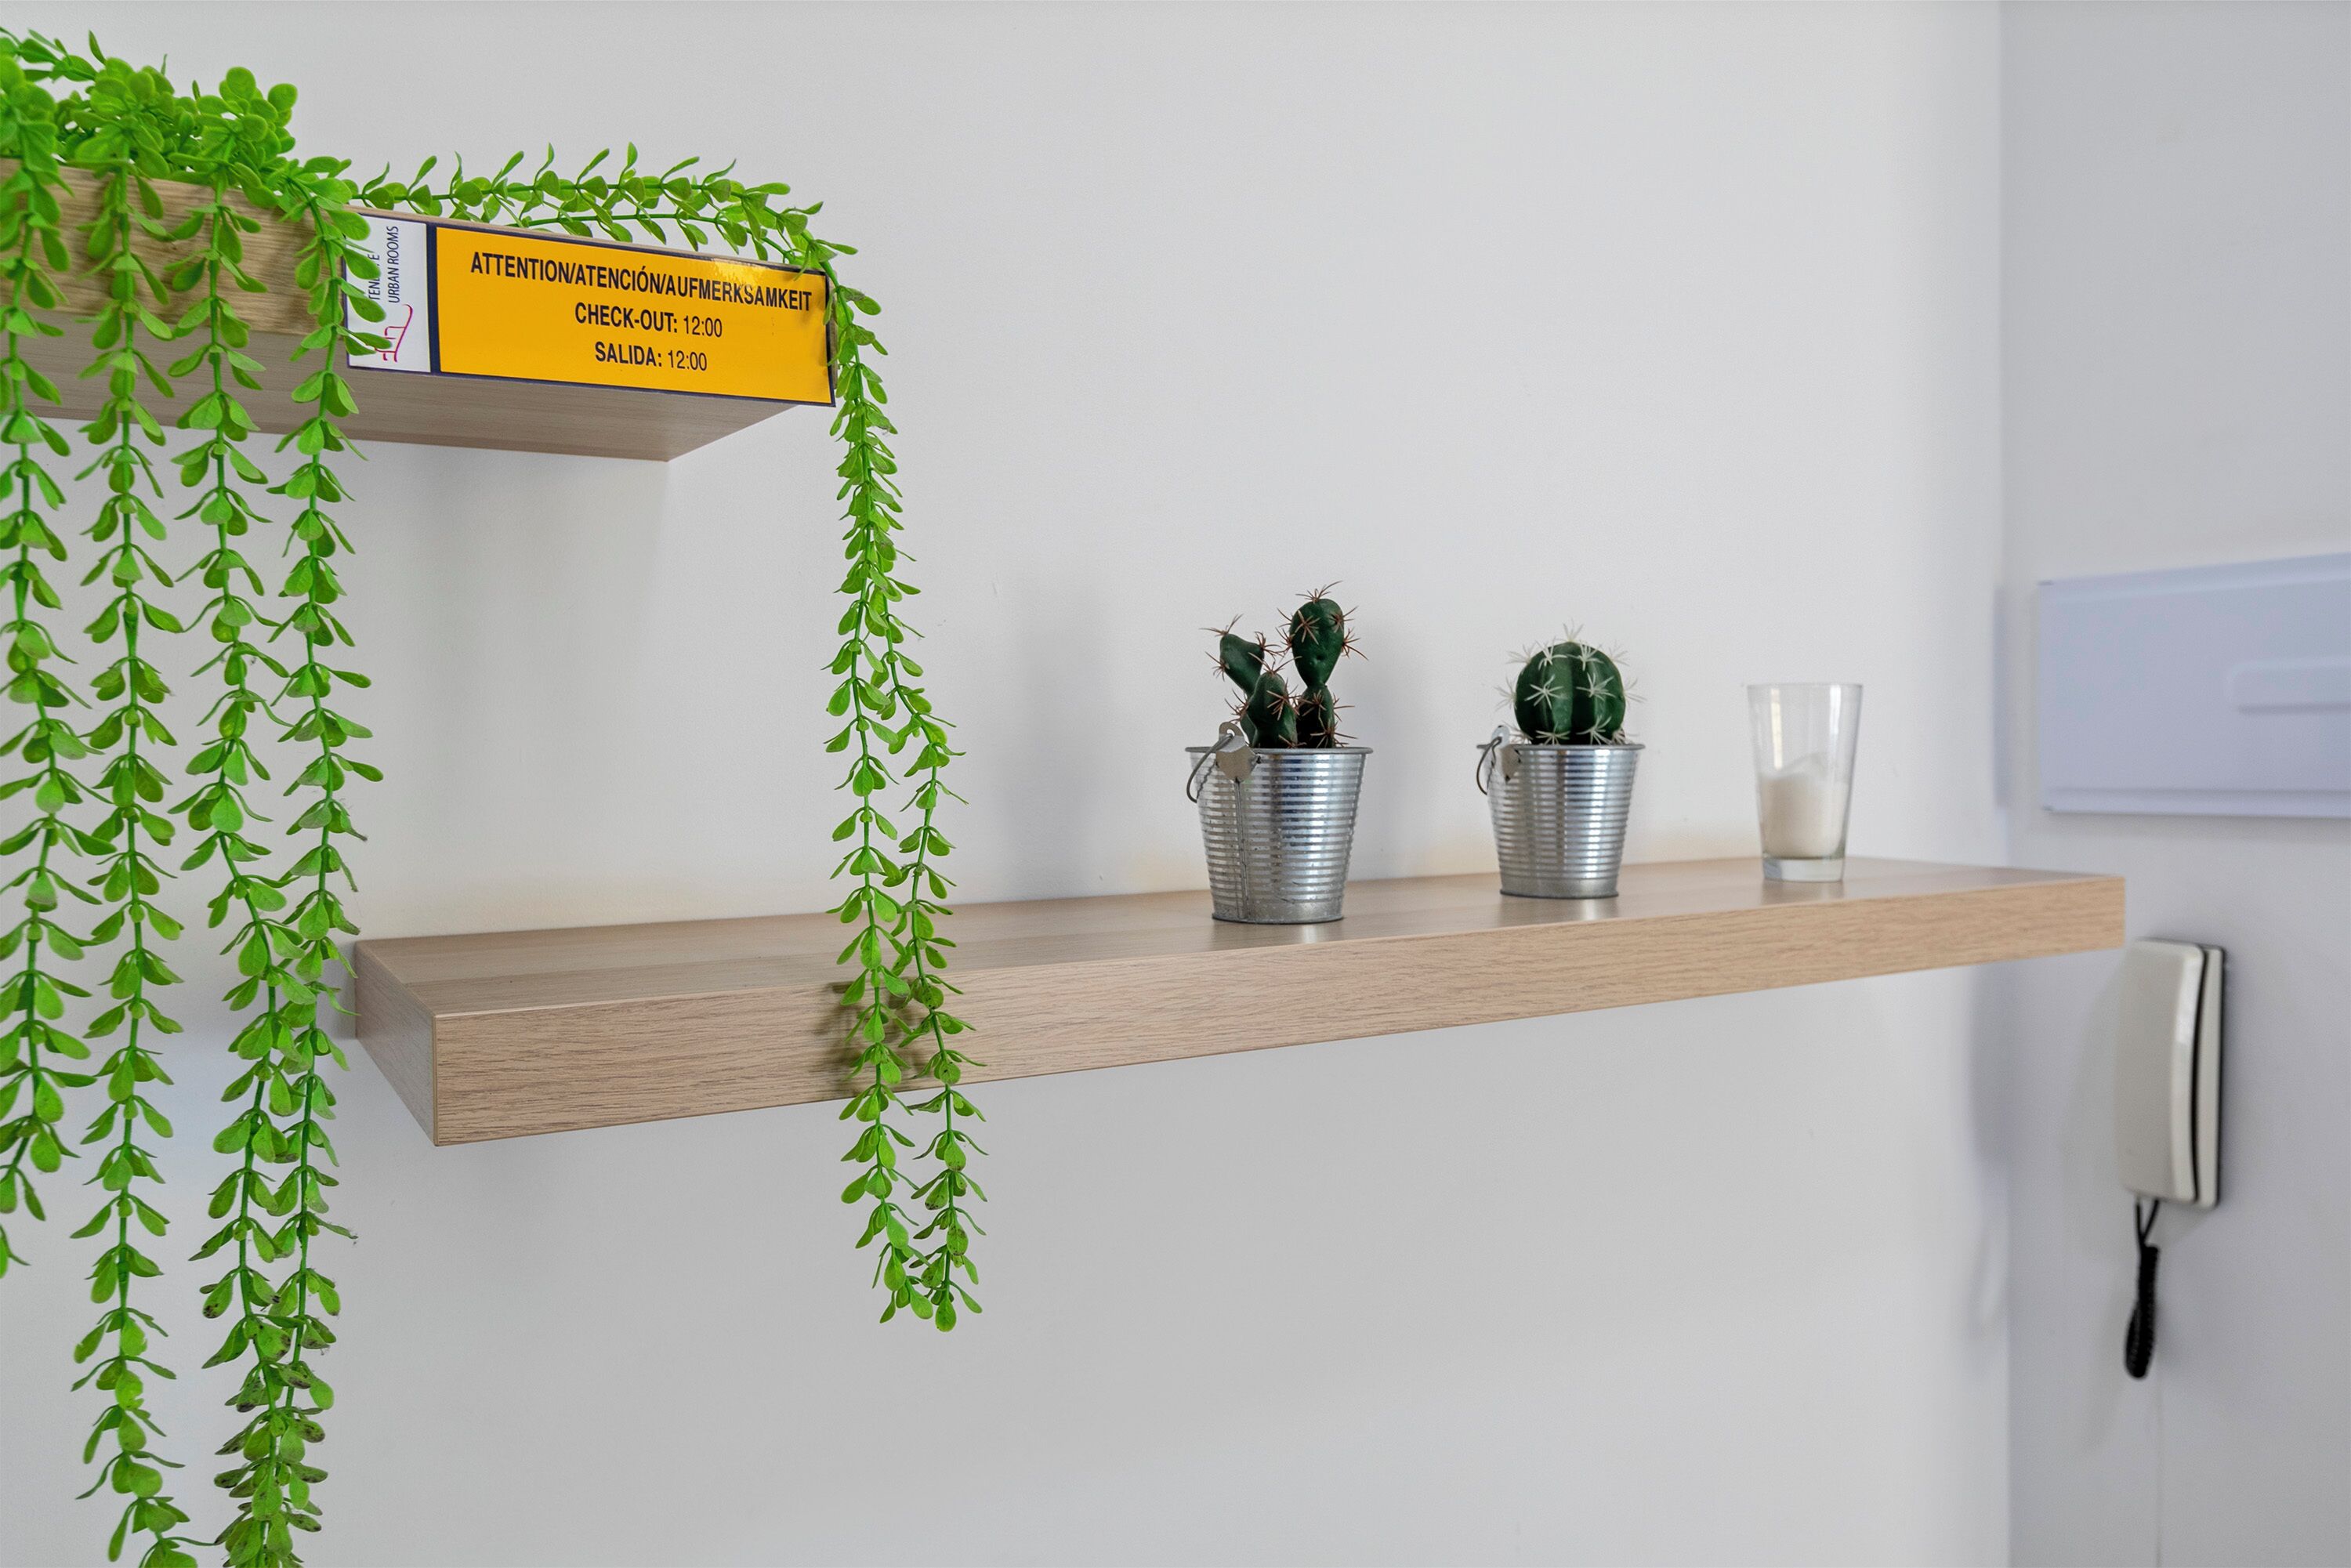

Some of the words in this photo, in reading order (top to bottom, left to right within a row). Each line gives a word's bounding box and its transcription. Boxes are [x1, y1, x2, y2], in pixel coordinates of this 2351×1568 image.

[386, 226, 400, 265] ROOMS
[387, 267, 400, 303] URBAN
[471, 252, 812, 312] ATTENTION/ATENCIÓN/AUFMERKSAMKEIT
[574, 302, 677, 333] CHECK-OUT:
[683, 315, 723, 338] 12:00
[595, 341, 662, 368] SALIDA:
[667, 349, 707, 371] 12:00
